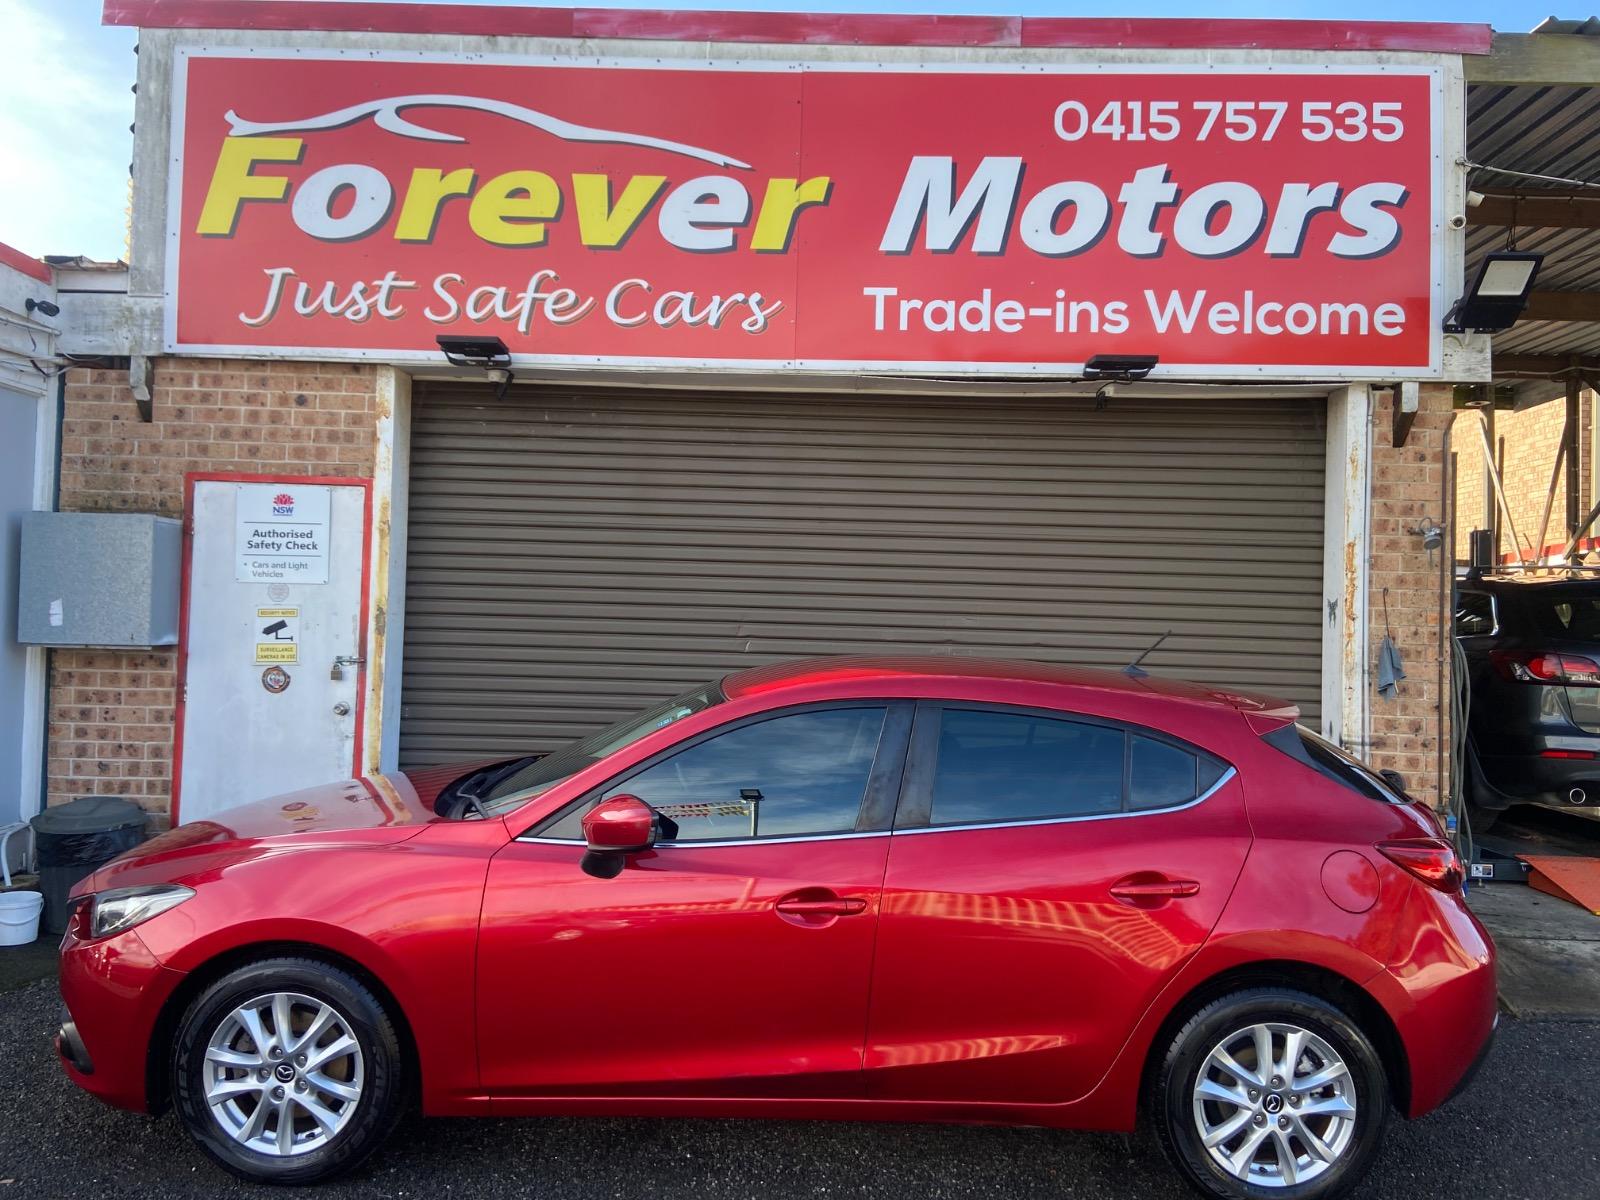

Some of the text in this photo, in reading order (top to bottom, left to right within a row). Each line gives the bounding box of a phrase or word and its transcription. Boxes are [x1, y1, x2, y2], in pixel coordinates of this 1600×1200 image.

[1053, 101, 1404, 142] 0415 757 535
[195, 136, 1411, 259] Forever Motors
[238, 266, 784, 335] Just Safe Cars
[863, 287, 1406, 337] Trade-ins Welcome
[272, 506, 293, 514] NSW
[247, 540, 318, 551] Safety Check
[252, 529, 313, 539] Authorised
[252, 561, 308, 571] Cars and Light
